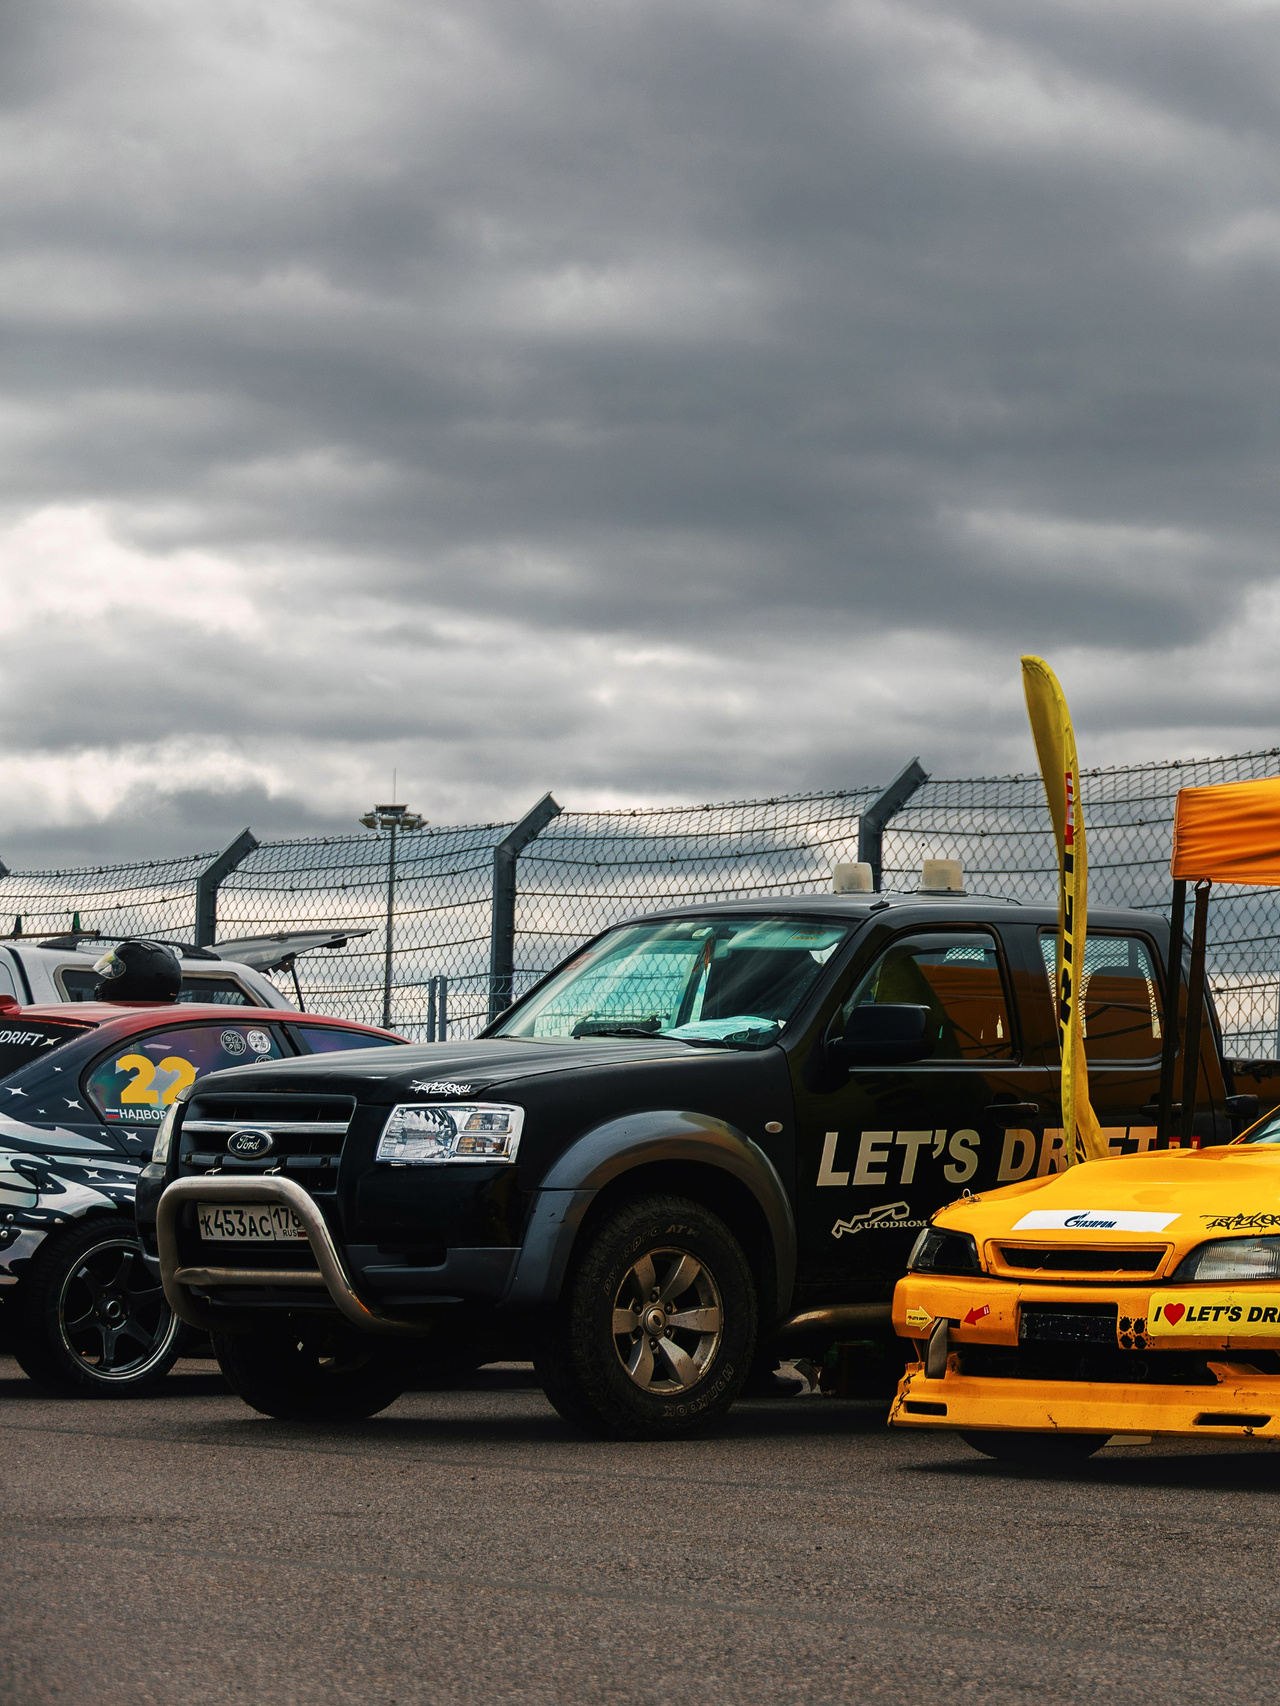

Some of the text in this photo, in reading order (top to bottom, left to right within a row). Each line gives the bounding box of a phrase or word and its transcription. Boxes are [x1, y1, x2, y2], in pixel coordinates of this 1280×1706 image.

[0, 1030, 44, 1046] DRIFT
[117, 1054, 196, 1104] 22
[236, 1134, 260, 1150] Ford
[996, 1126, 1158, 1182] DRFT
[855, 1219, 927, 1231] AUTODROM
[1153, 1306, 1162, 1322] I
